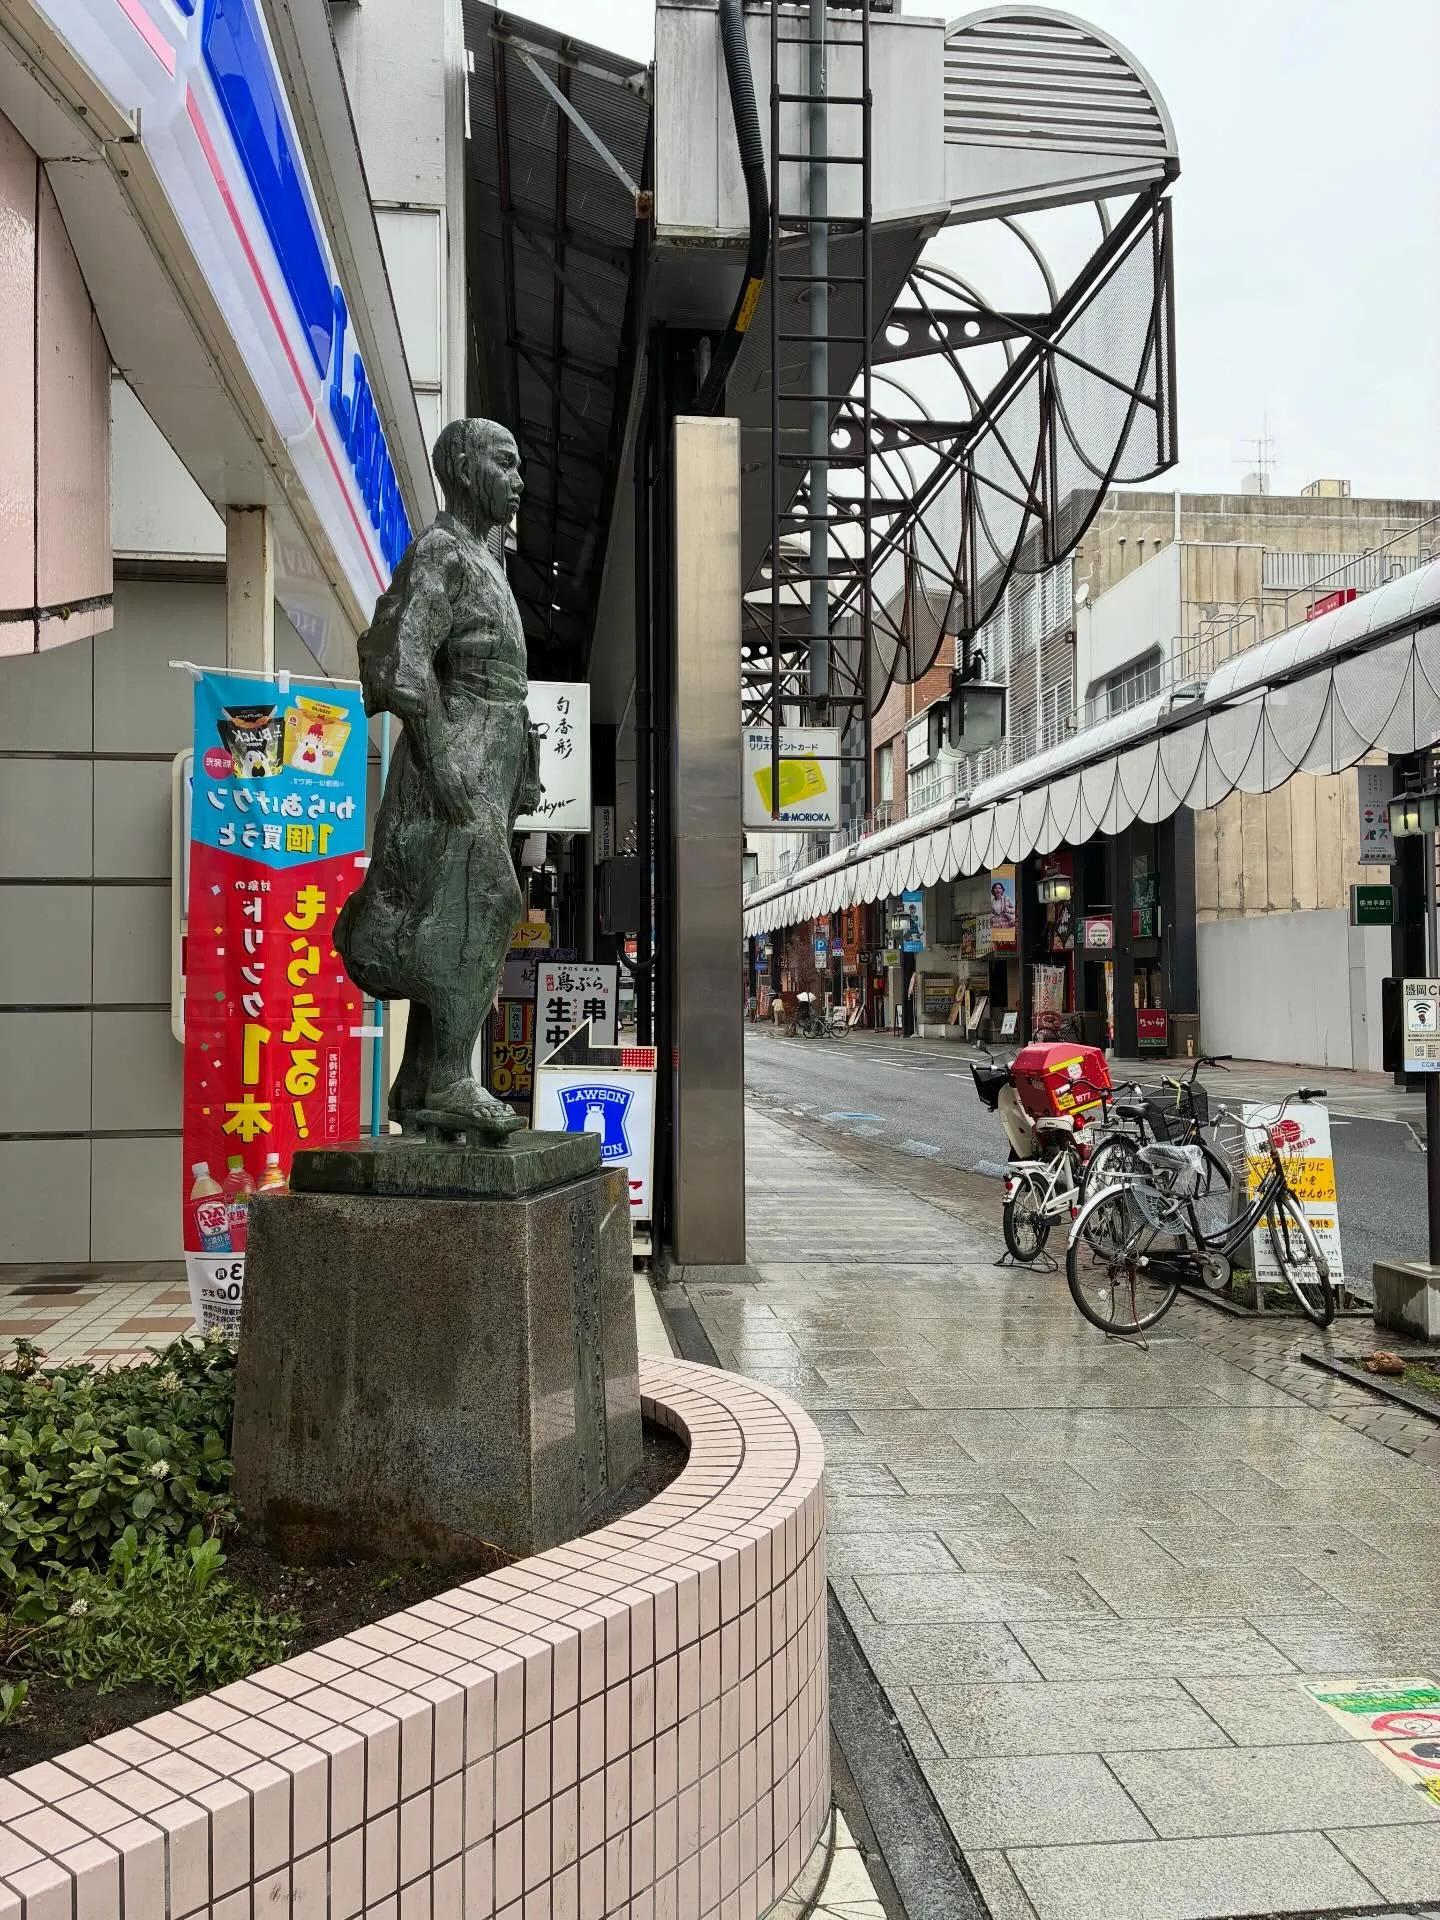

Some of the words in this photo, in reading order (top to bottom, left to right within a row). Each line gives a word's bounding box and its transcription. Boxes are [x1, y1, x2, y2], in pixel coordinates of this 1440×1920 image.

[748, 735, 783, 743] 買物上に
[749, 743, 818, 751] リリオイントカード
[1406, 985, 1426, 995] 盛岡
[1428, 985, 1440, 995] C
[583, 998, 606, 1023] 串
[546, 997, 572, 1050] 生中
[565, 1089, 627, 1105] LAWSON
